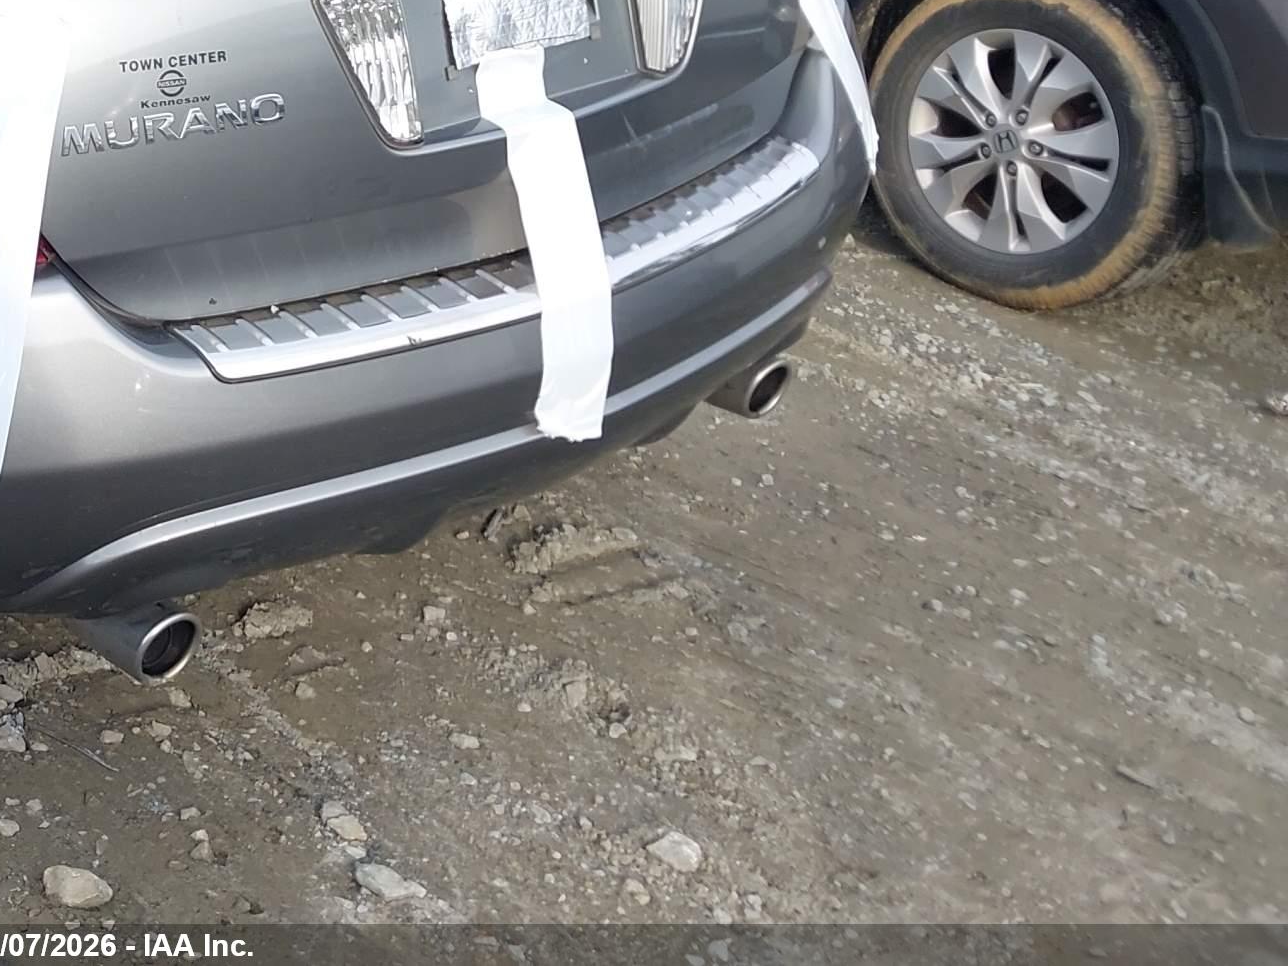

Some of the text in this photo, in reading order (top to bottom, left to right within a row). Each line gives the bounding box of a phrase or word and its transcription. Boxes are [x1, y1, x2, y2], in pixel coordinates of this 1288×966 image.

[119, 50, 227, 73] TOWN CENTER
[140, 94, 211, 109] Kennesaw
[61, 92, 286, 157] MURANO
